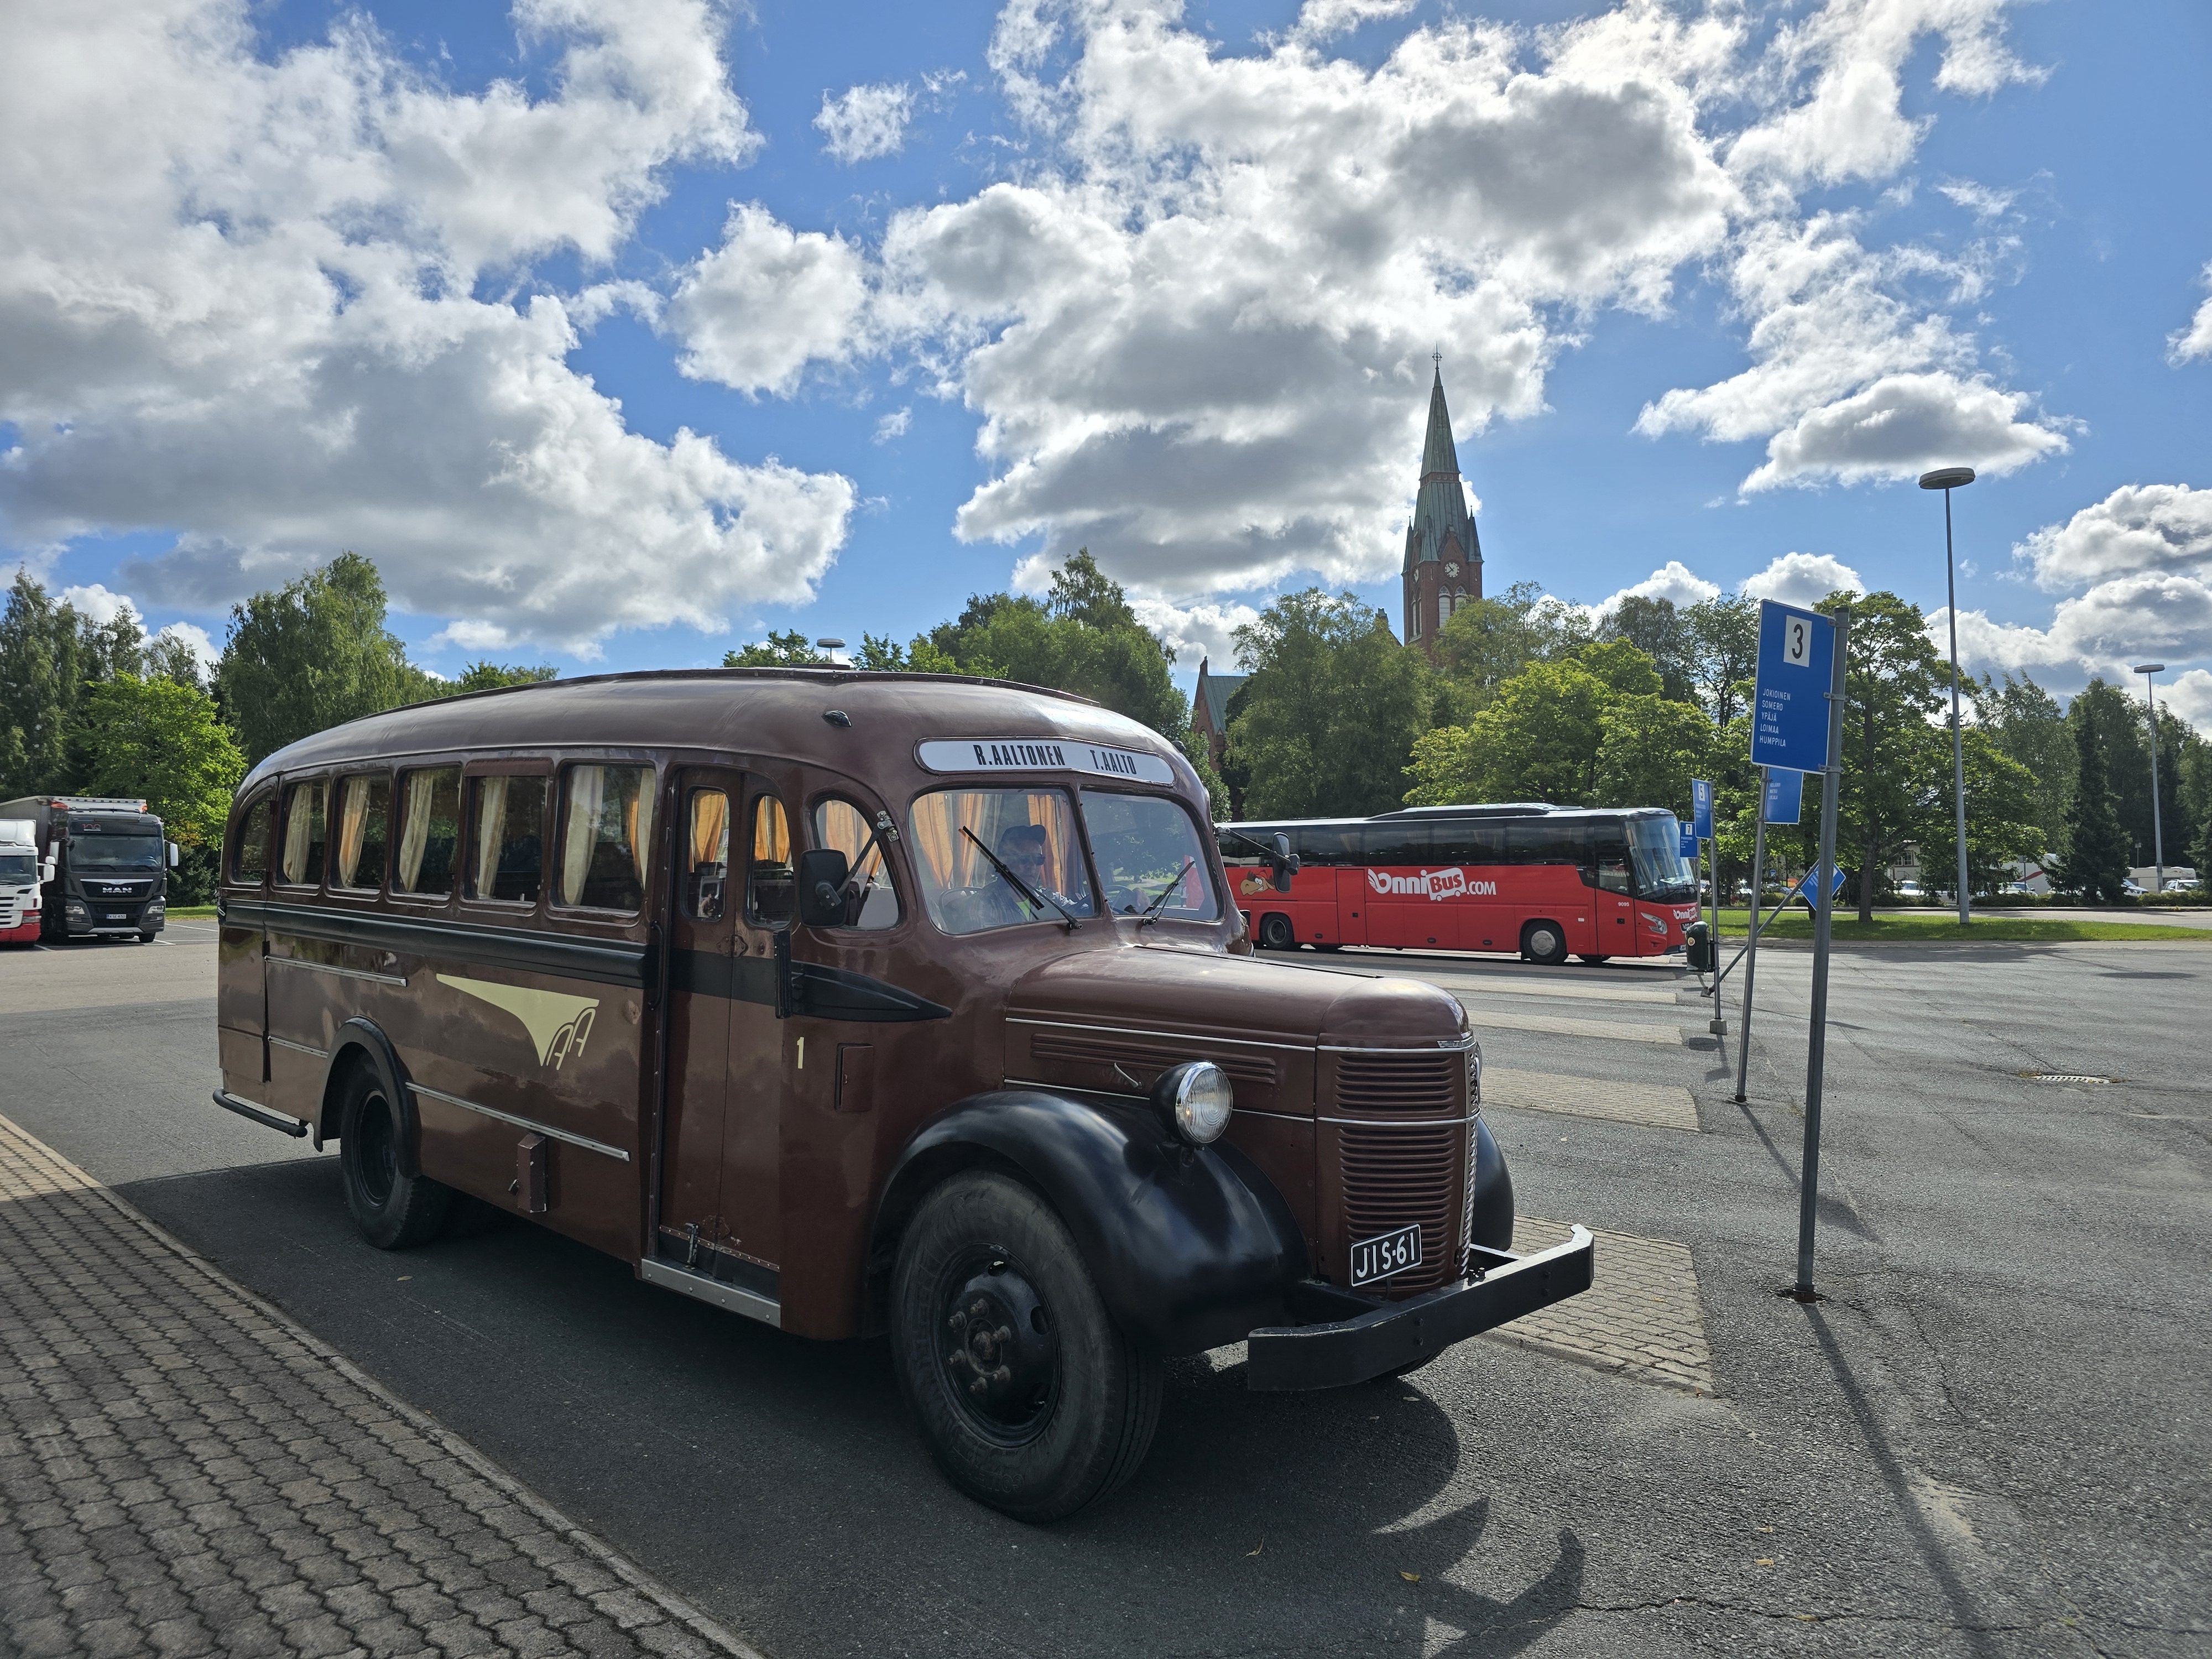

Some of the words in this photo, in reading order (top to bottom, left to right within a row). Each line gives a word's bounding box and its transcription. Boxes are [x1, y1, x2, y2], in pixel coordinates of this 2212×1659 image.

[1792, 623, 1803, 659] 3
[1762, 688, 1791, 701] JOKIOINEN
[1762, 700, 1783, 711] SOMERO
[1761, 711, 1777, 722] YPÄJÄ
[1760, 723, 1779, 734] LOIMAA
[1759, 735, 1786, 747] HUMPPILA
[973, 744, 1066, 765] R.AALTONEN
[1089, 749, 1137, 775] T.AALTO
[1700, 786, 1703, 799] 5
[1687, 825, 1691, 834] 7
[796, 1036, 805, 1070] 1
[1356, 1232, 1416, 1278] JIS-61
